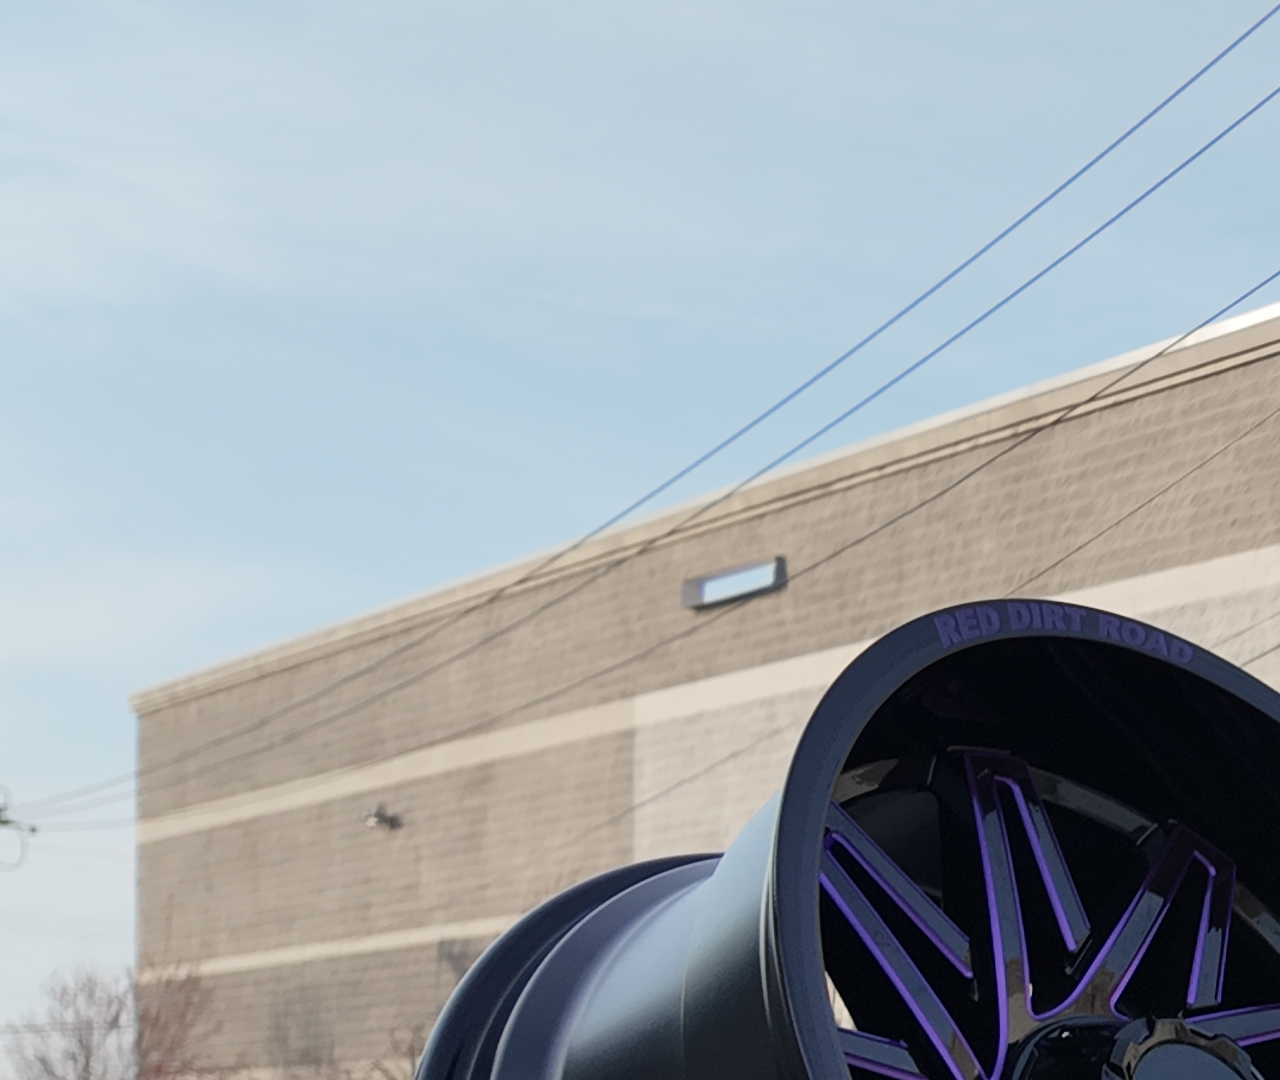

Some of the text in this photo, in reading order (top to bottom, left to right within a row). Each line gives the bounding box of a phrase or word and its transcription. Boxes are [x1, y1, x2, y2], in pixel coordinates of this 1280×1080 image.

[934, 602, 1195, 665] RED DIRT ROAD
